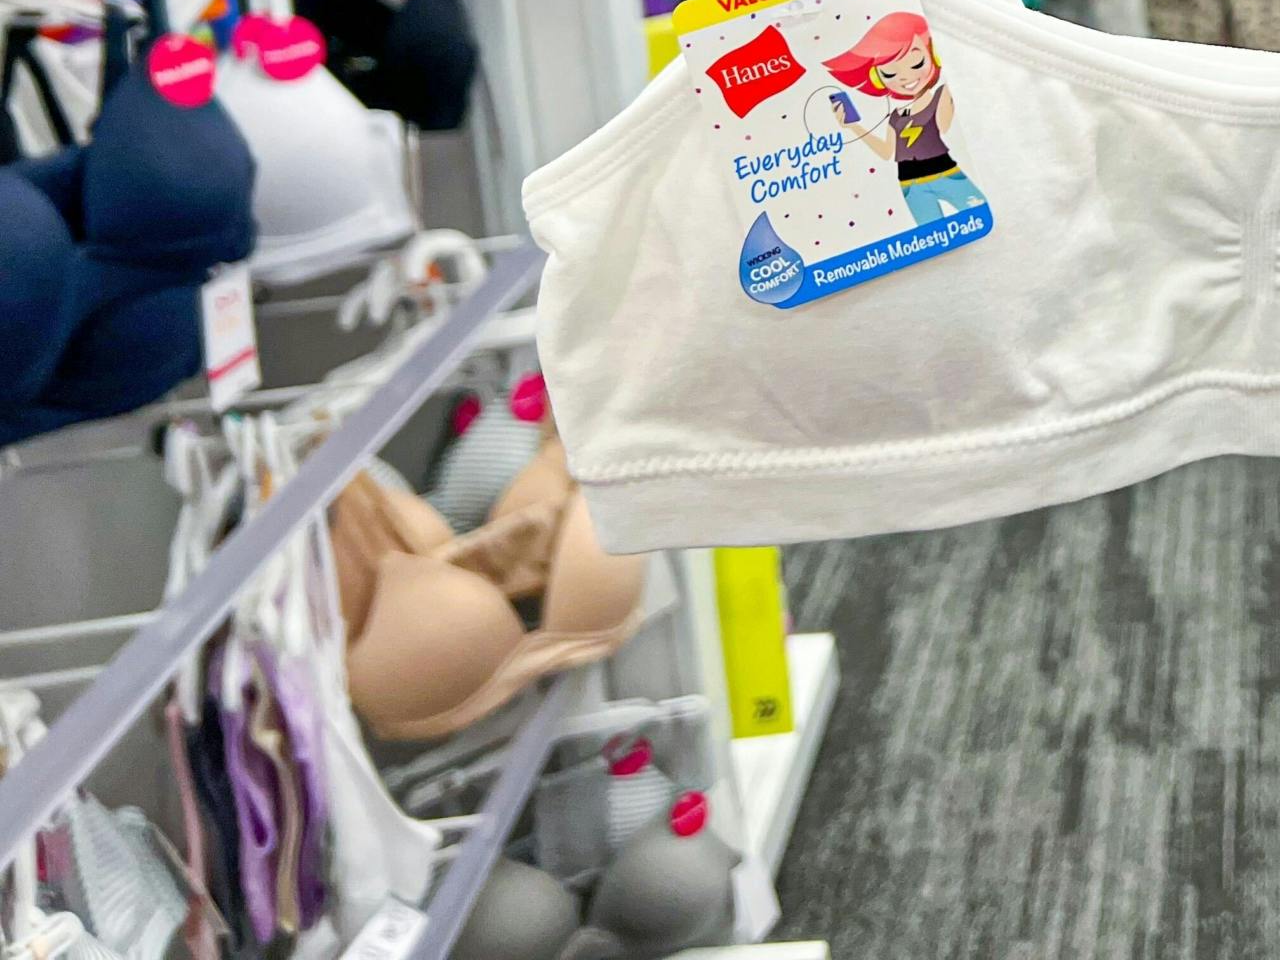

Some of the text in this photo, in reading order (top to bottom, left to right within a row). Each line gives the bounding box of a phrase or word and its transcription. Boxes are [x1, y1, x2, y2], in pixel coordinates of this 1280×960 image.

[721, 54, 792, 89] Hanes
[734, 132, 843, 180] Everyday
[751, 156, 842, 203] Comfort
[747, 245, 782, 266] WICKING
[813, 215, 984, 287] Removable Modesty Pads
[750, 257, 790, 282] COOL
[750, 262, 800, 293] COMFORT
